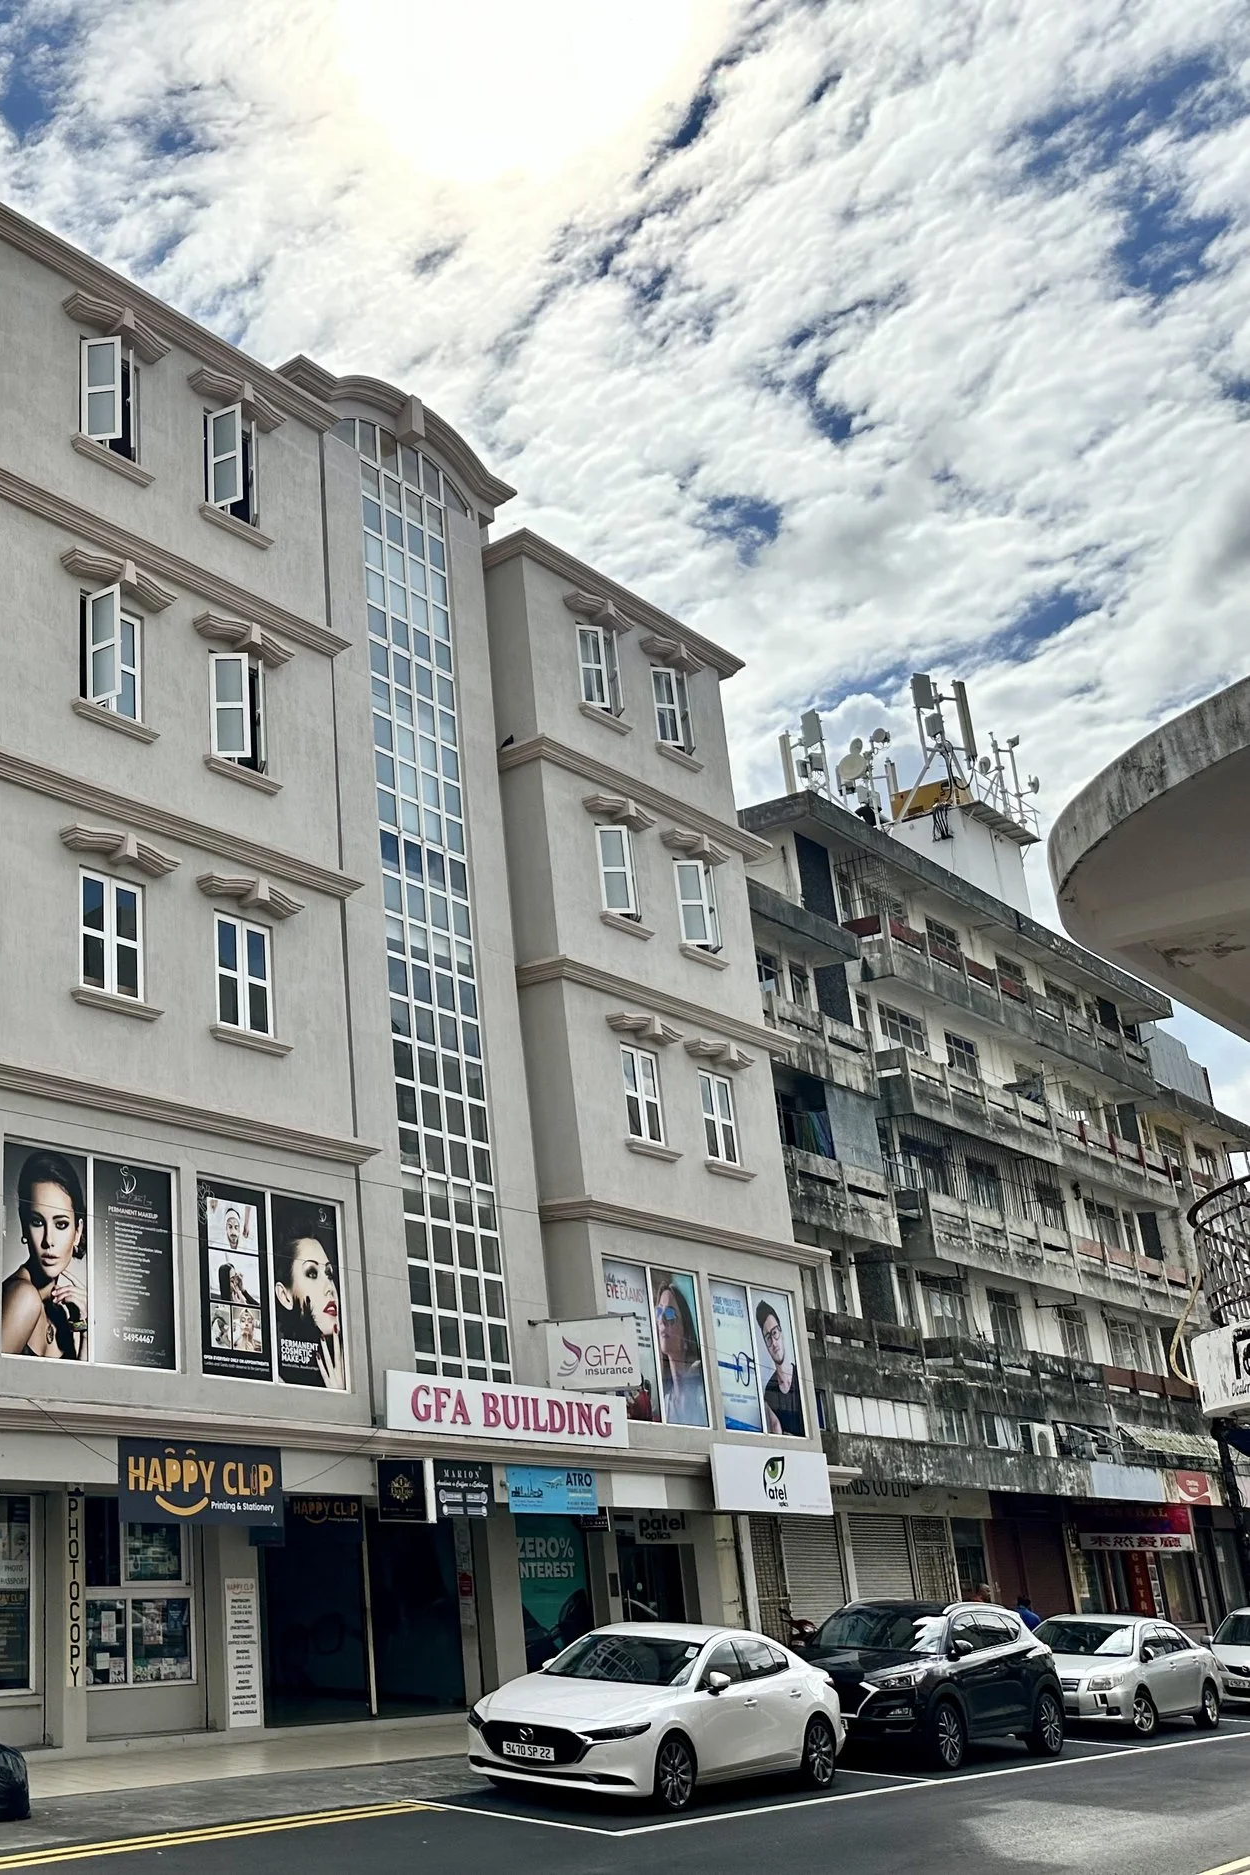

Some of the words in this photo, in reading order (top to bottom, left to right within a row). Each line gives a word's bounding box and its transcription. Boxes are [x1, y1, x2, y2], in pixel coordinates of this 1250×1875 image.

[606, 1283, 619, 1299] EYE
[123, 1333, 154, 1344] 54954467
[281, 1339, 318, 1350] PERMANENT
[281, 1346, 312, 1357] COSMETIC
[282, 1354, 310, 1364] MAKE-UP
[585, 1344, 631, 1367] GFA
[585, 1366, 634, 1376] insurance
[411, 1384, 472, 1425] GFA
[482, 1392, 612, 1438] BUILDING
[128, 1456, 215, 1494] HAPPY
[223, 1462, 274, 1496] CLIP
[444, 1469, 480, 1480] MARION
[566, 1472, 592, 1487] ATRO
[211, 1500, 236, 1512] Printing
[237, 1502, 242, 1510] &
[243, 1502, 274, 1514] Stationery
[293, 1500, 330, 1515] HAPPY
[639, 1512, 686, 1536] patel
[645, 1532, 672, 1541] optics
[516, 1536, 574, 1559] ZERO%
[5, 1564, 24, 1573] PHOTO
[519, 1562, 576, 1578] NTEREST
[0, 1577, 28, 1586] PASSPORT
[68, 1498, 80, 1687] PHOTOCOPY
[506, 1743, 526, 1756] 9470
[528, 1746, 538, 1756] SP
[540, 1748, 550, 1758] 22
